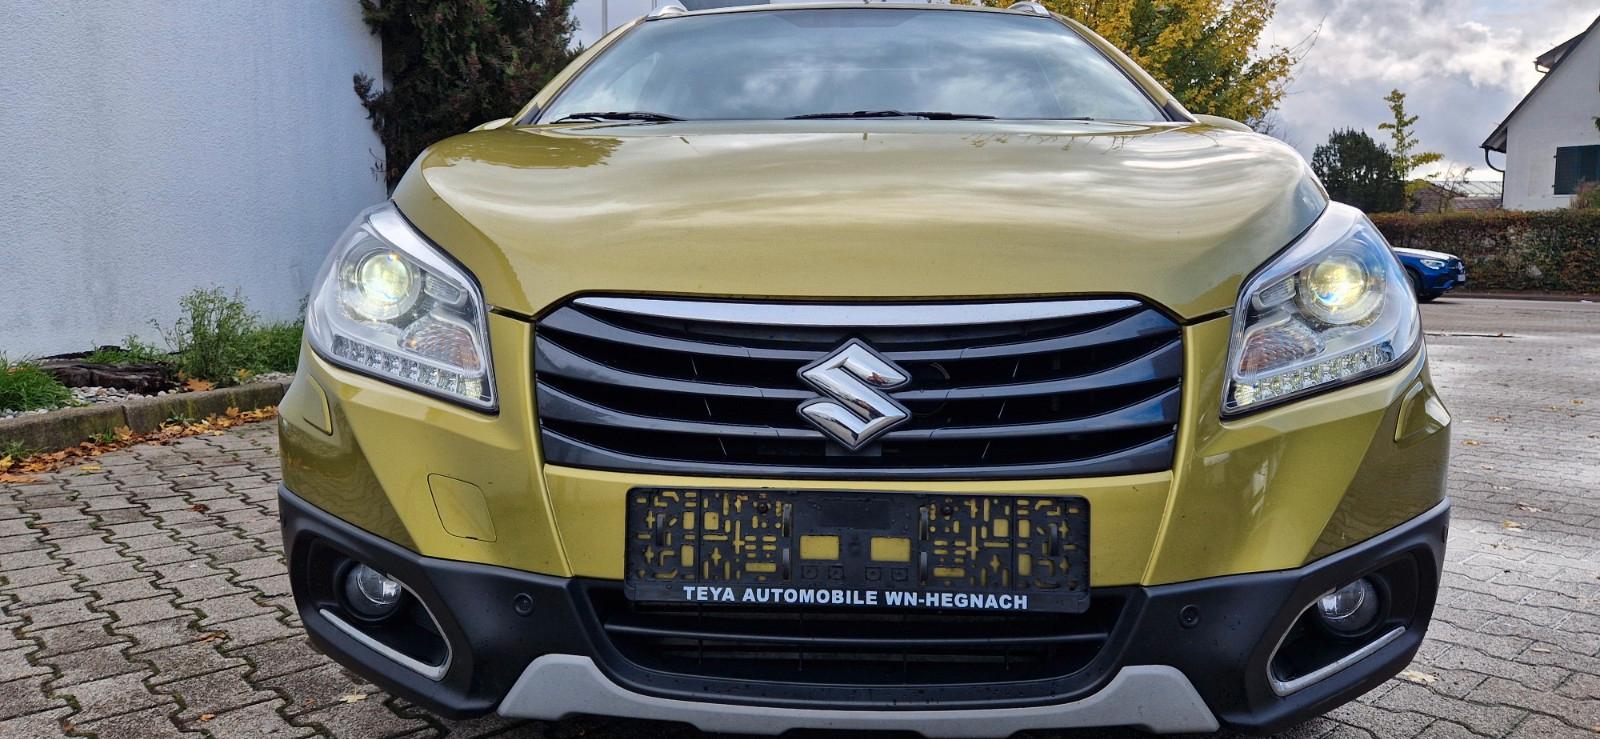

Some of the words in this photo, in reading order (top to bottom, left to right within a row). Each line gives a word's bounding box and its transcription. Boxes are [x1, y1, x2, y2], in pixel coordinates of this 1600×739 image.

[682, 586, 735, 602] TEYA
[743, 587, 878, 605] AUTOMOBILE
[885, 591, 1028, 610] WN-HEGNACH
